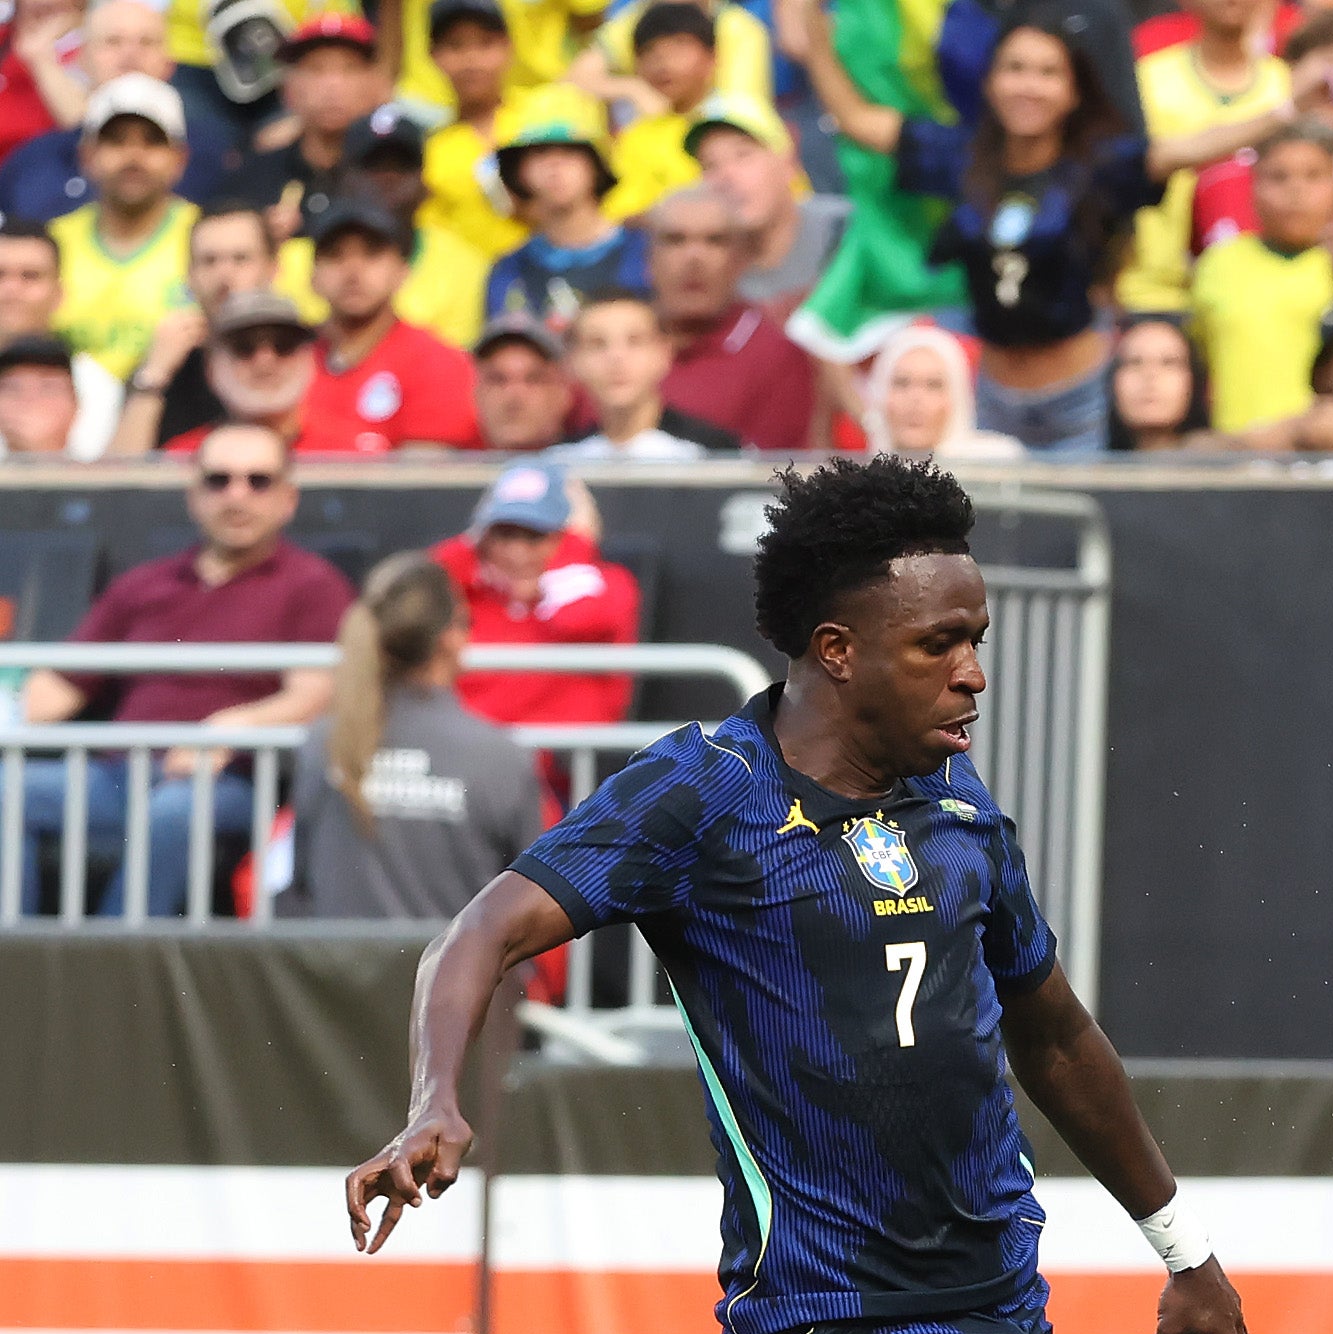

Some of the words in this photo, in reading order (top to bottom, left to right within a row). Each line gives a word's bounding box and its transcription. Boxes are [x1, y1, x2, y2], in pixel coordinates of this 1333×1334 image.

[872, 850, 893, 860] CBF
[873, 896, 933, 916] BRASIL
[885, 941, 927, 1047] 7
